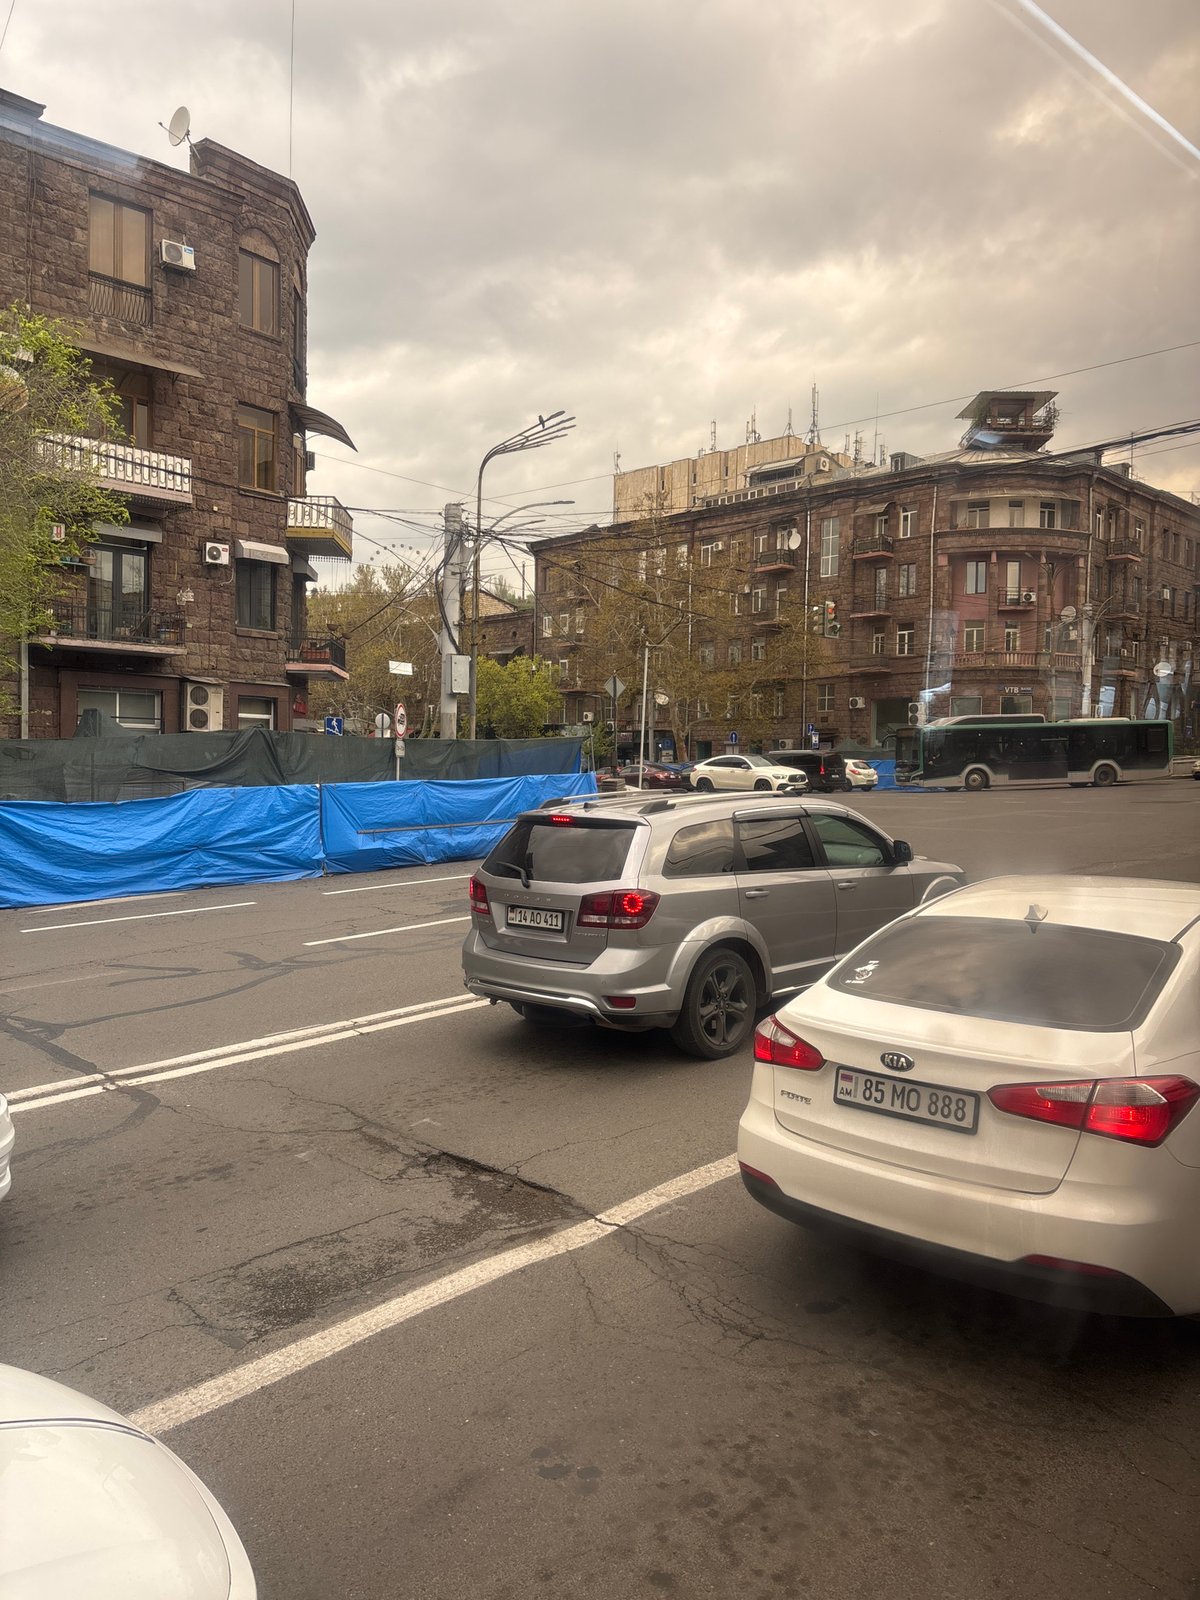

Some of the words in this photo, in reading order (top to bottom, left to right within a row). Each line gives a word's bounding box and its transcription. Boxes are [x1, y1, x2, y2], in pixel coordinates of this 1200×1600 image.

[1004, 686, 1019, 694] VTB
[518, 910, 528, 923] 14
[530, 911, 541, 925] AO
[544, 913, 559, 927] 411
[884, 1053, 907, 1069] KIA
[839, 1087, 852, 1097] AM
[863, 1078, 885, 1104] 85
[890, 1084, 921, 1112] MO
[927, 1092, 967, 1122] 888
